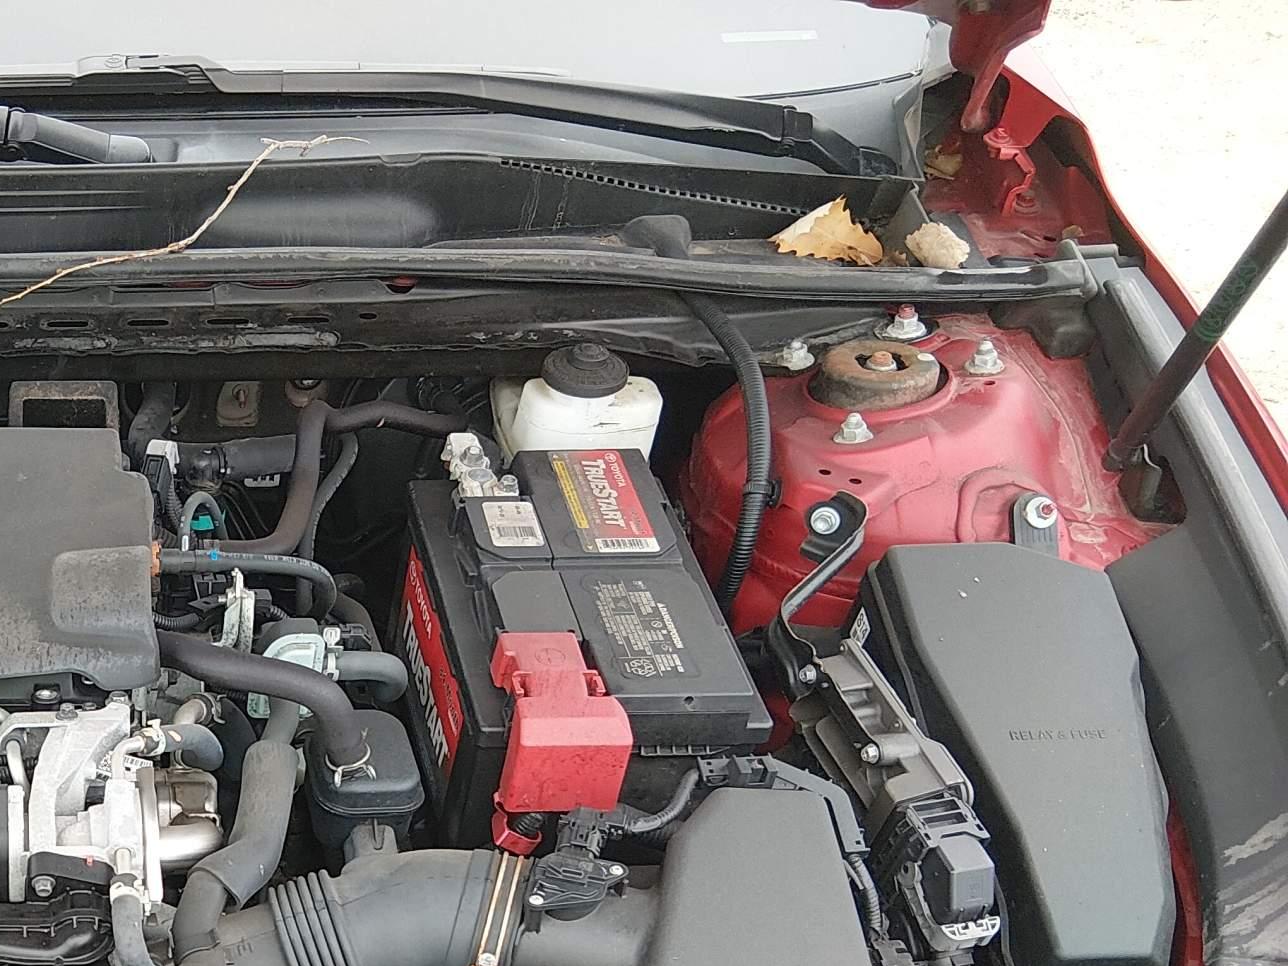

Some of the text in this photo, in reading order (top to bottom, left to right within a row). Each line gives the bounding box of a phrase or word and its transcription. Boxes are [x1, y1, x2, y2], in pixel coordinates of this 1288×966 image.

[609, 464, 626, 488] TOYOTA
[414, 579, 432, 640] TOYOTA
[1008, 729, 1054, 742] RELAY
[1070, 729, 1107, 740] FUSE
